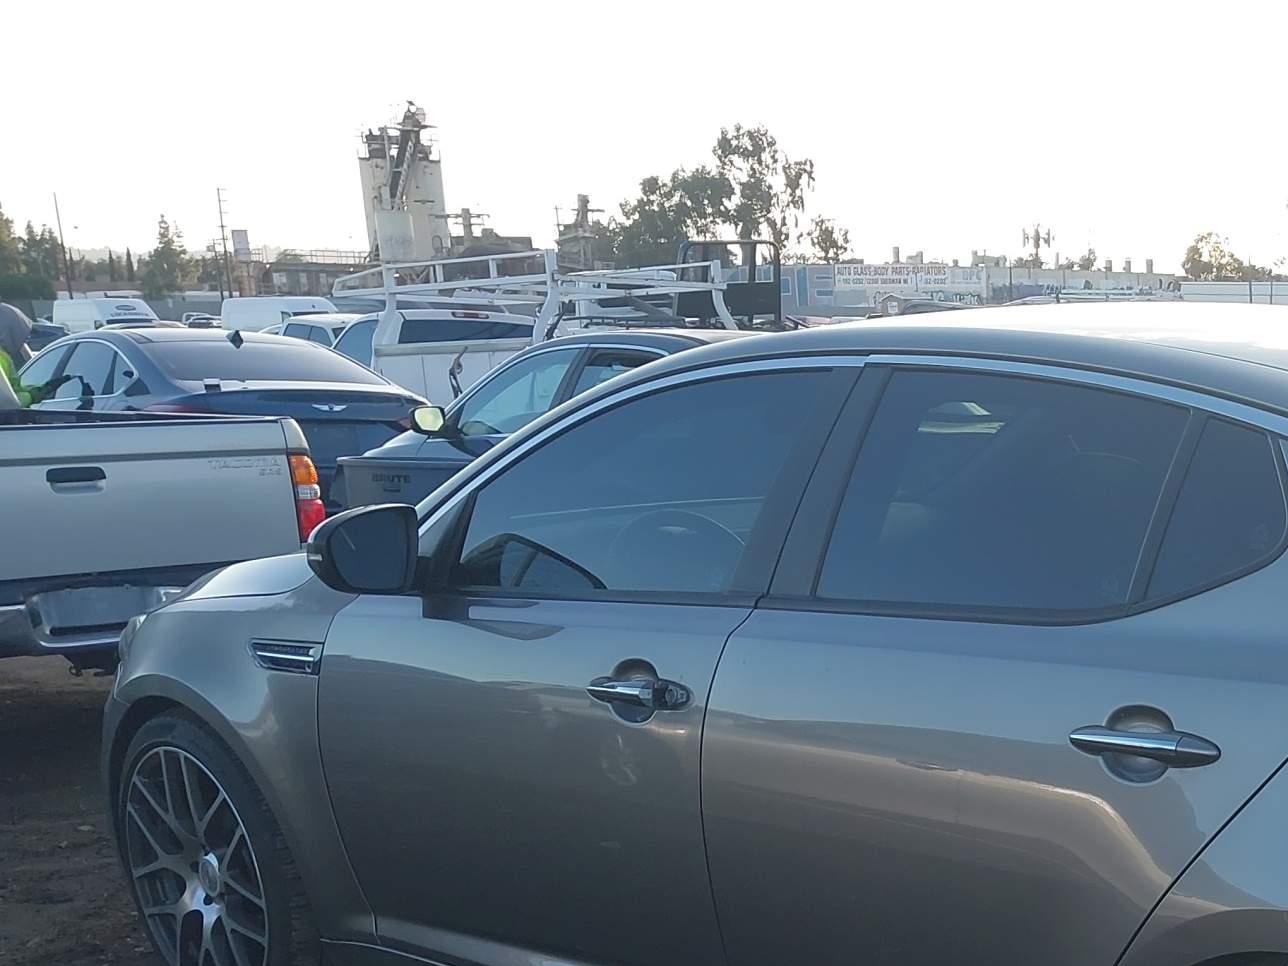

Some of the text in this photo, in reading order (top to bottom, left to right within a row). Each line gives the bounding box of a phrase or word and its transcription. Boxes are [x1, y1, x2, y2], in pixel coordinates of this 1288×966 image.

[836, 266, 851, 276] AUTO
[207, 457, 281, 469] TACOMA
[371, 473, 411, 483] BRUTE
